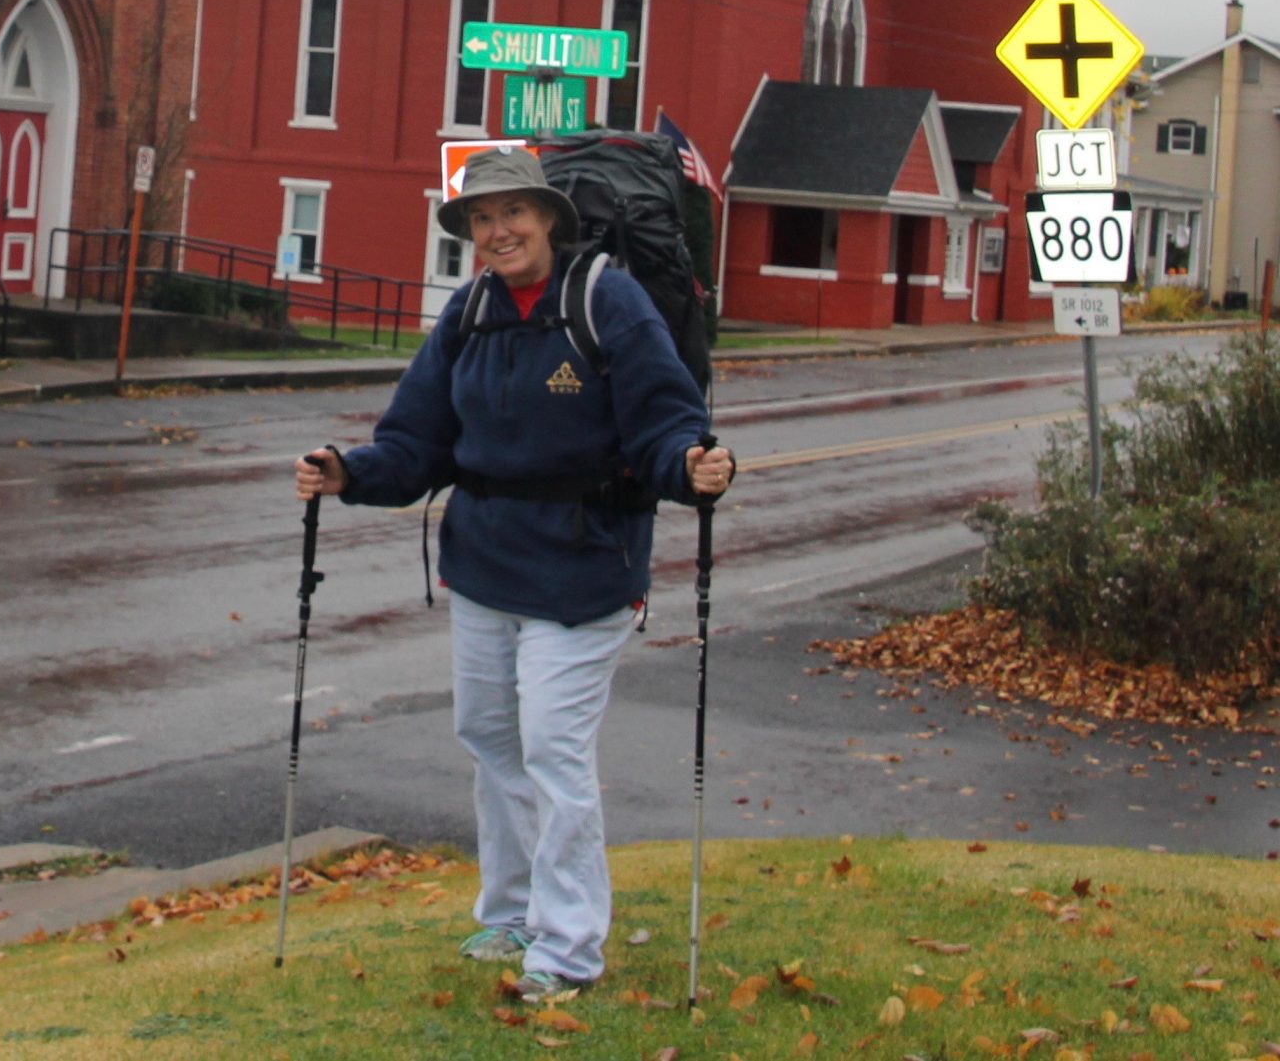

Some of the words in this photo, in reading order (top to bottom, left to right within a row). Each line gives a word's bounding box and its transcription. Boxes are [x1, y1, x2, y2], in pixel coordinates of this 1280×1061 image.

[490, 30, 601, 68] SMULLTON
[611, 38, 619, 70] 1
[508, 97, 517, 130] E
[521, 82, 564, 130] MAIN
[566, 98, 580, 129] ST
[1047, 142, 1106, 177] JCT
[1040, 216, 1124, 261] 880
[1061, 298, 1076, 311] SR
[1080, 298, 1103, 312] 1012
[1094, 314, 1109, 328] BR
